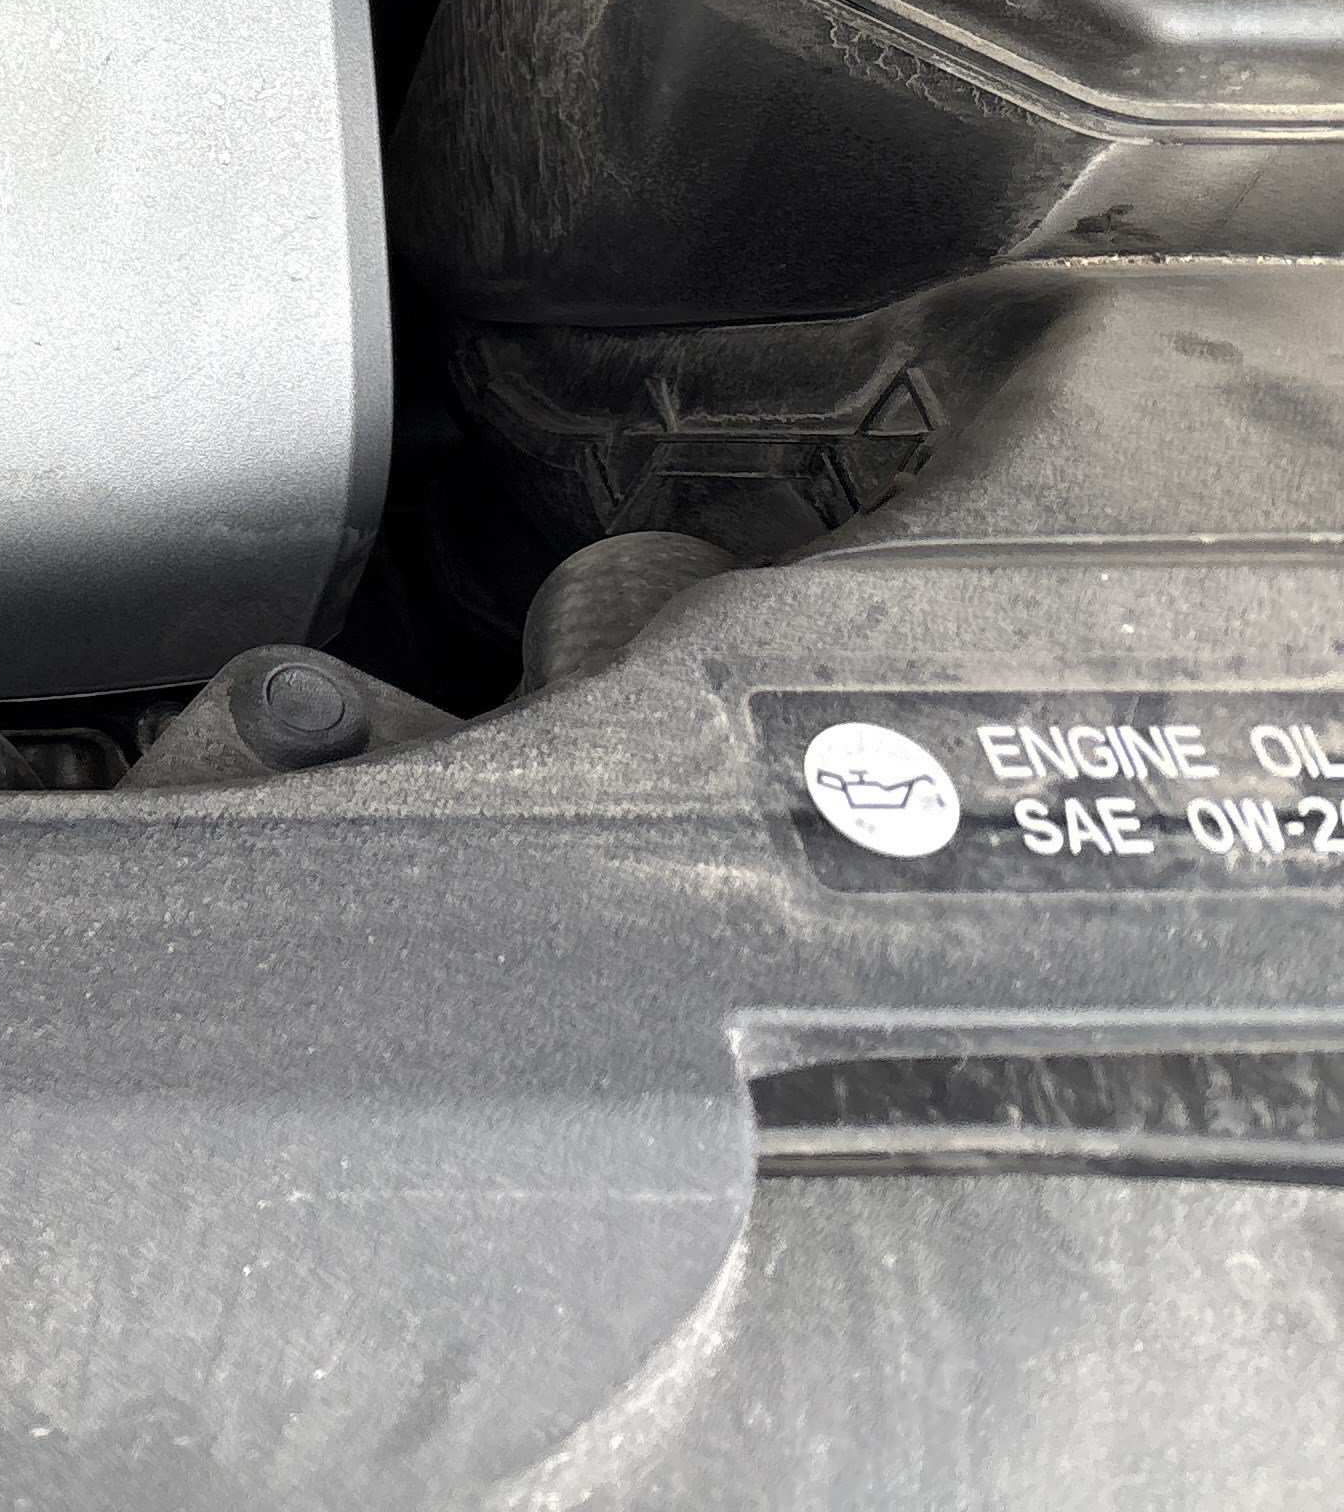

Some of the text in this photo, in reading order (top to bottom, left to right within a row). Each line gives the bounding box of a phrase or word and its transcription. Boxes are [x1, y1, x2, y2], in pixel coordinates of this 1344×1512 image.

[977, 724, 1344, 780] ENGINE OIL
[1014, 796, 1344, 855] SAE 0W-2
